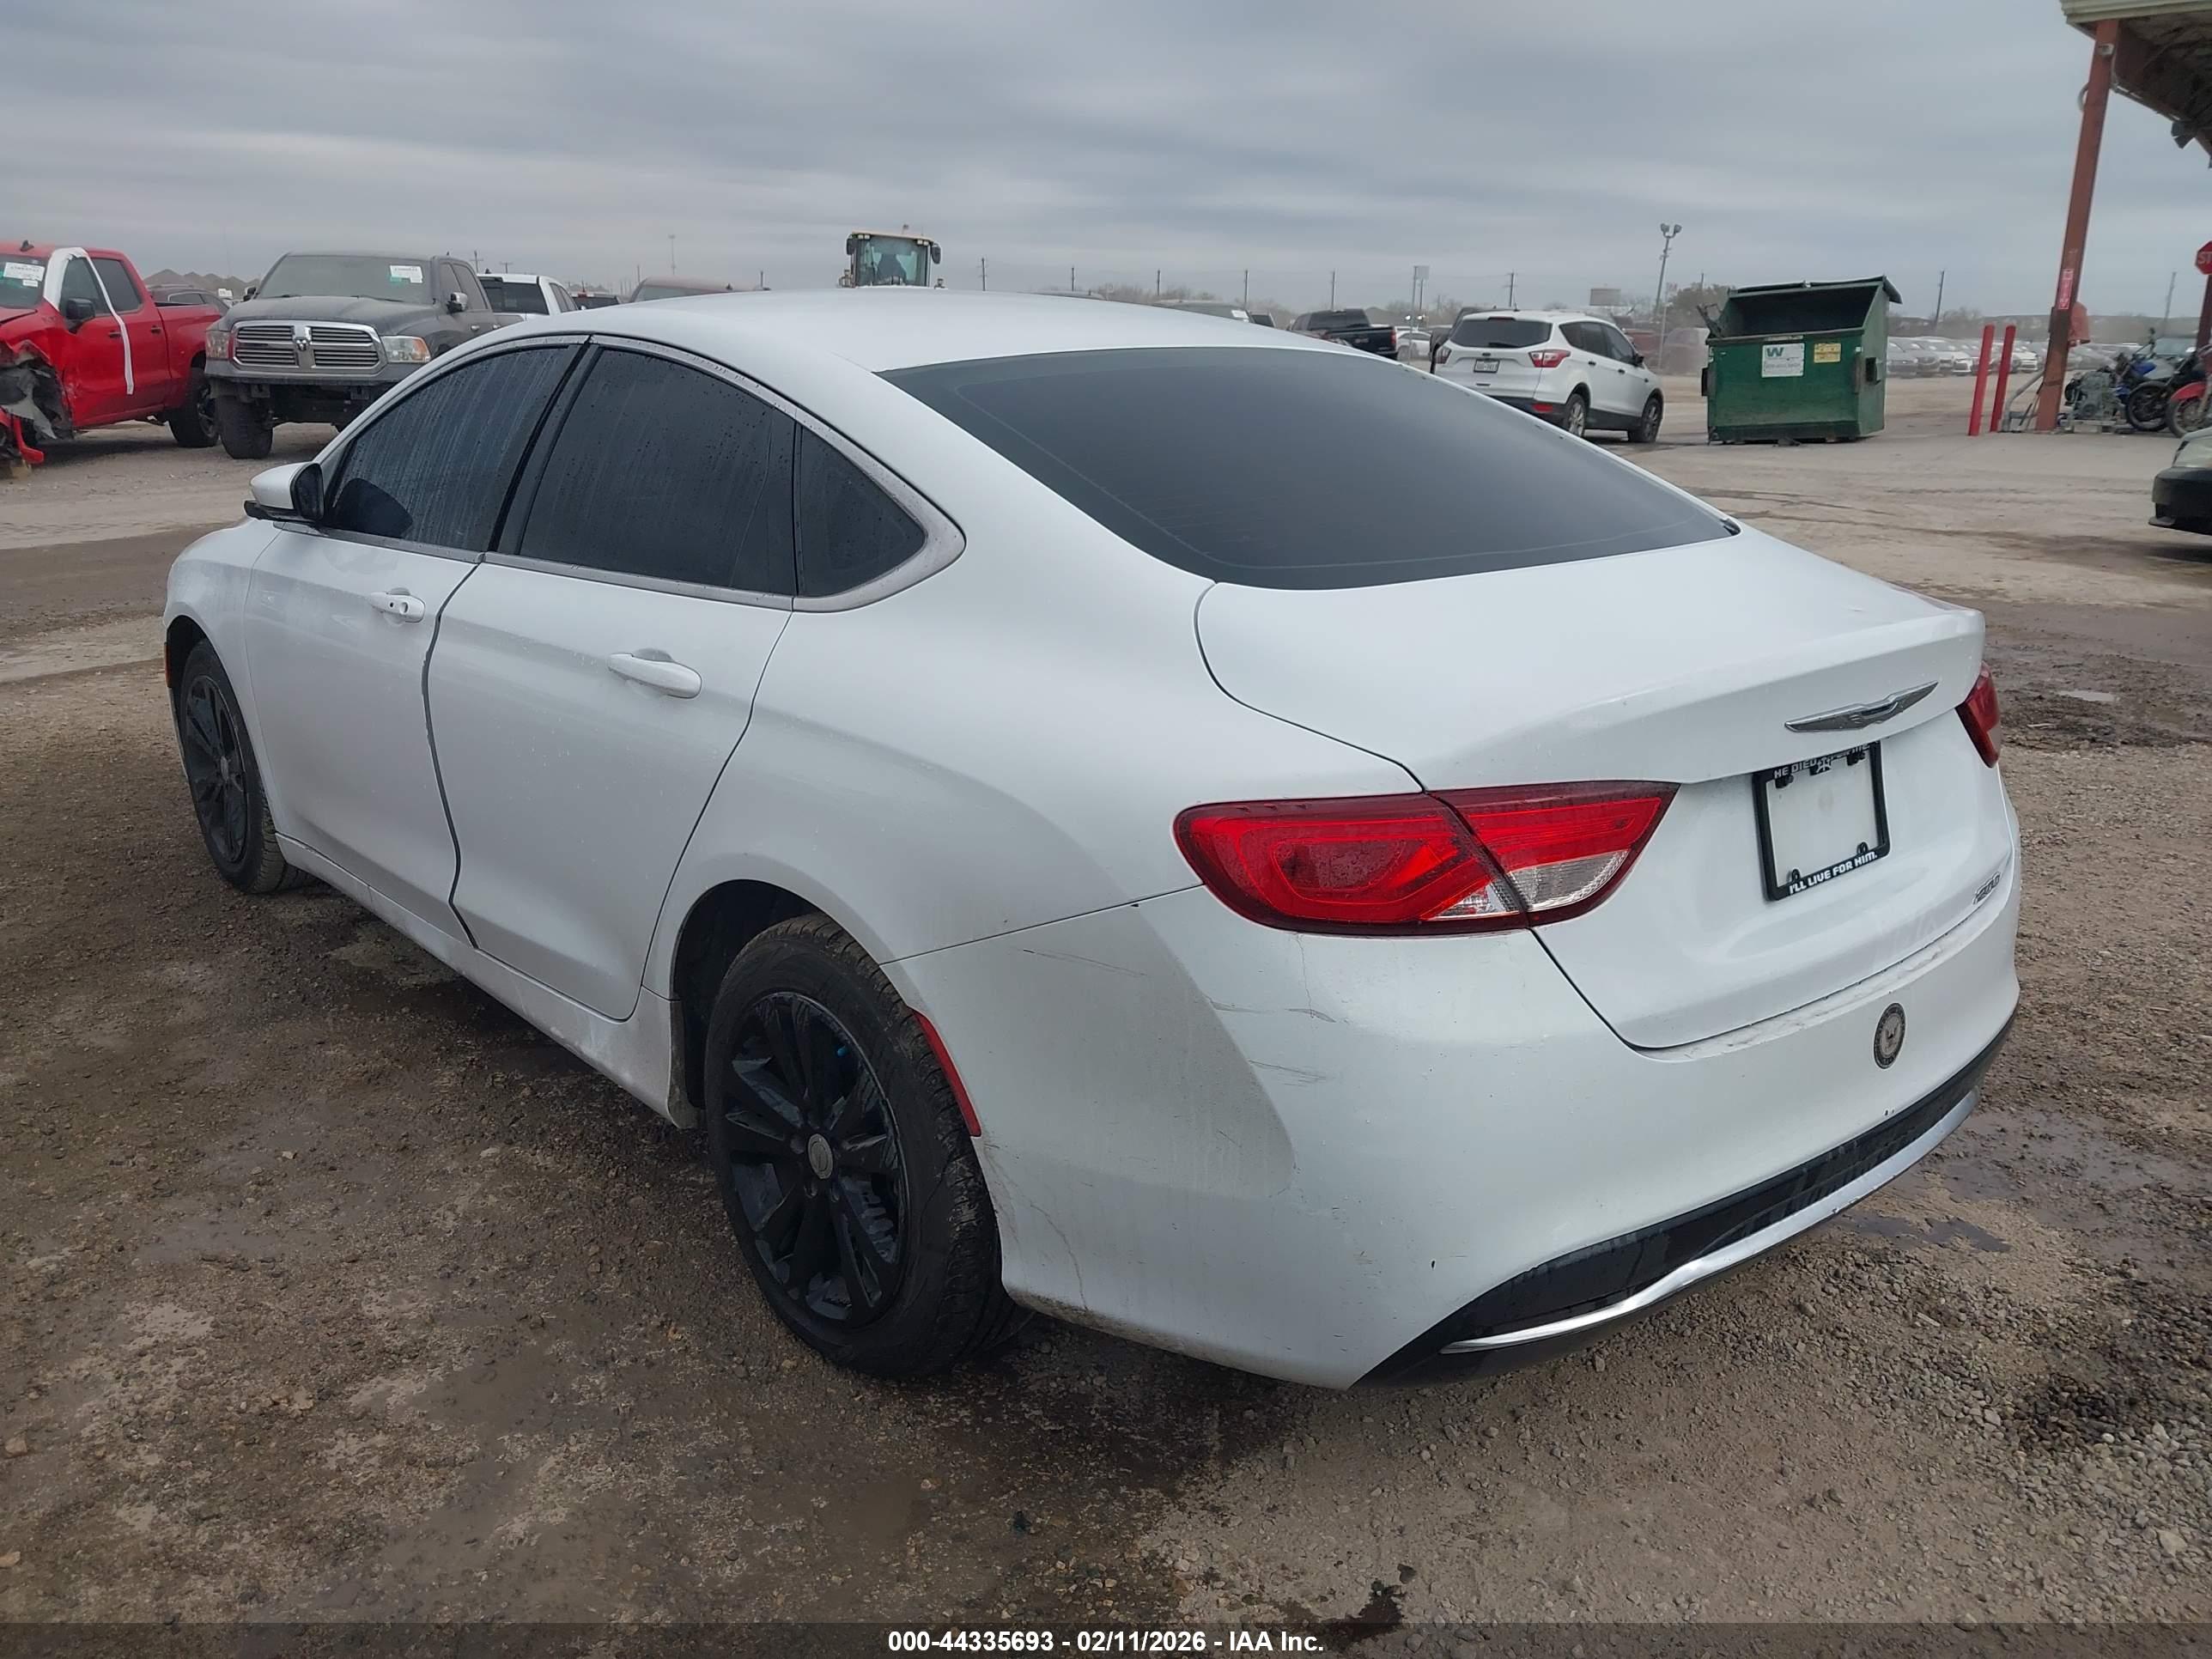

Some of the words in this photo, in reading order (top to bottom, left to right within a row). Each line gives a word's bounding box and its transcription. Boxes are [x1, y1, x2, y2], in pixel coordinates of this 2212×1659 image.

[2198, 251, 2212, 264] ST
[1773, 766, 1790, 780] HE
[1791, 758, 1818, 774] DIED
[1789, 881, 1808, 895] I'LL
[1808, 870, 1831, 886] LIVE
[1832, 860, 1853, 876] FOR
[1854, 851, 1878, 867] HIM.
